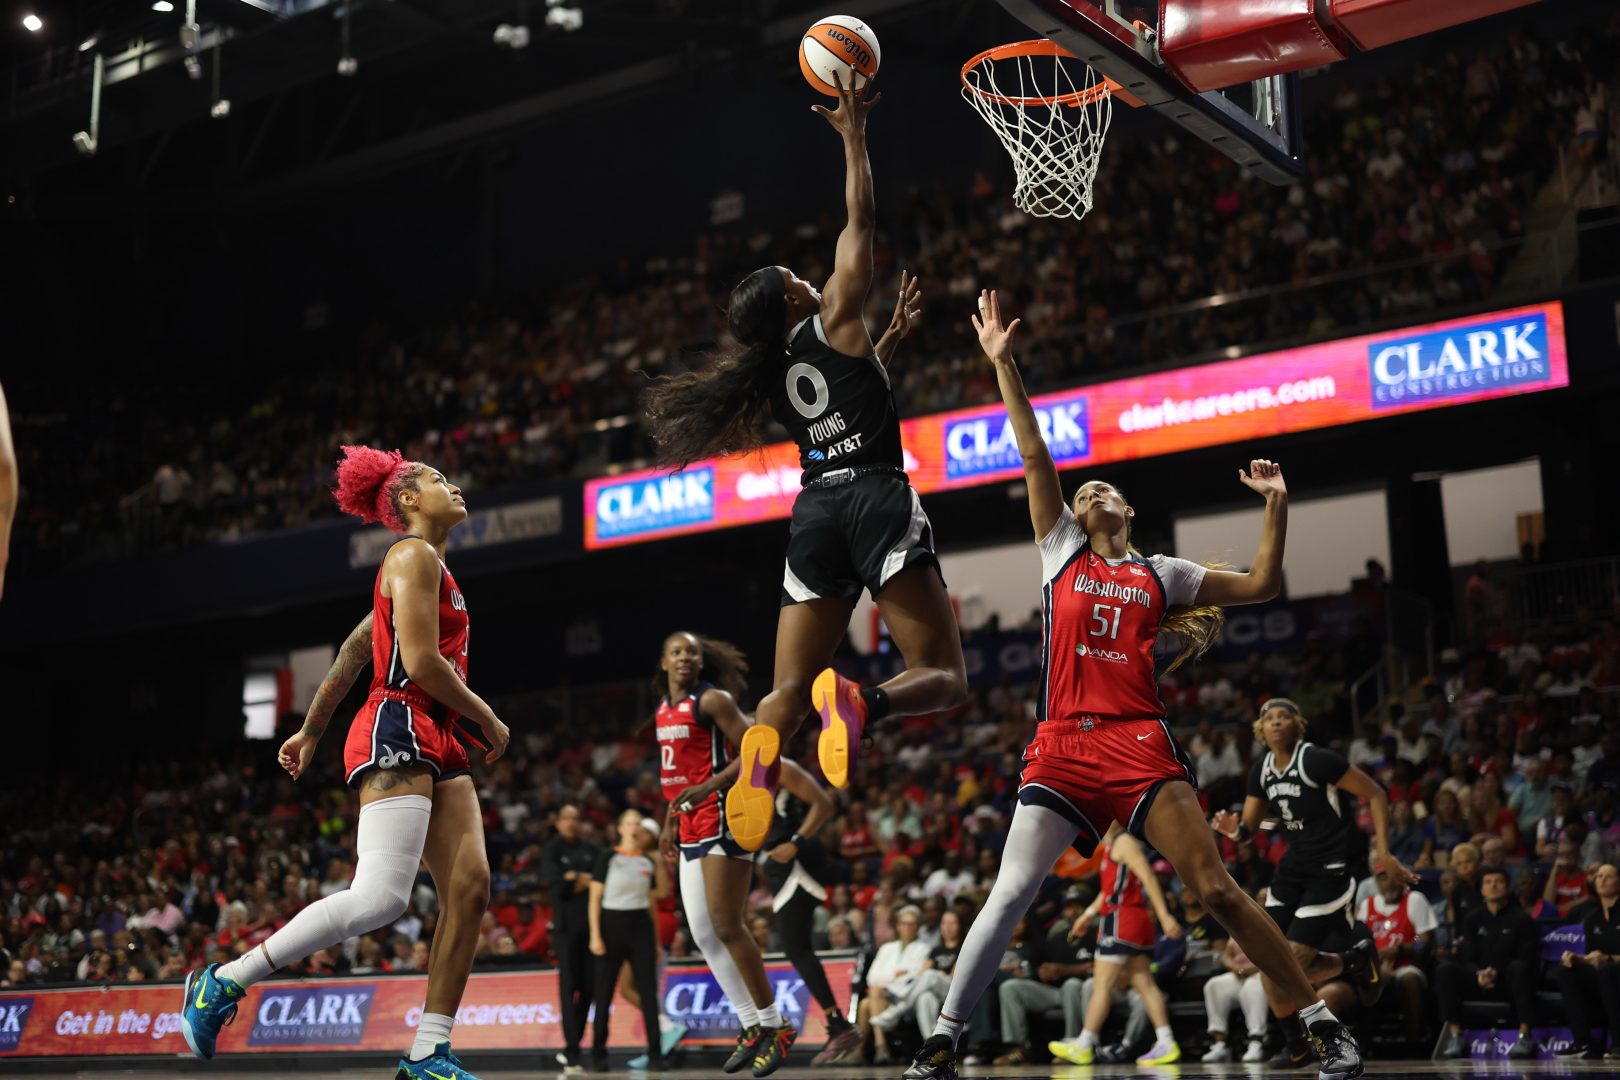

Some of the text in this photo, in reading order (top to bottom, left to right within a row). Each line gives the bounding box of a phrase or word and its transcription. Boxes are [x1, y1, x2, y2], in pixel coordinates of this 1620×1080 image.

[826, 28, 870, 68] Wilson
[1374, 320, 1541, 386] CLARK
[785, 362, 829, 419] 0
[1375, 358, 1545, 402] CONSTRUCTION
[1118, 374, 1336, 434] clarkcareers.com
[807, 411, 846, 445] YOUNG
[827, 432, 863, 460] AT&T
[597, 469, 712, 523] CLARK
[1074, 573, 1151, 609] Washington
[1090, 603, 1122, 640] 51
[1086, 646, 1129, 662] VANDA
[55, 1011, 92, 1036] Get
[93, 1009, 111, 1035] in
[117, 1008, 150, 1035] the
[151, 1012, 184, 1040] ga
[257, 993, 370, 1027] CLARK
